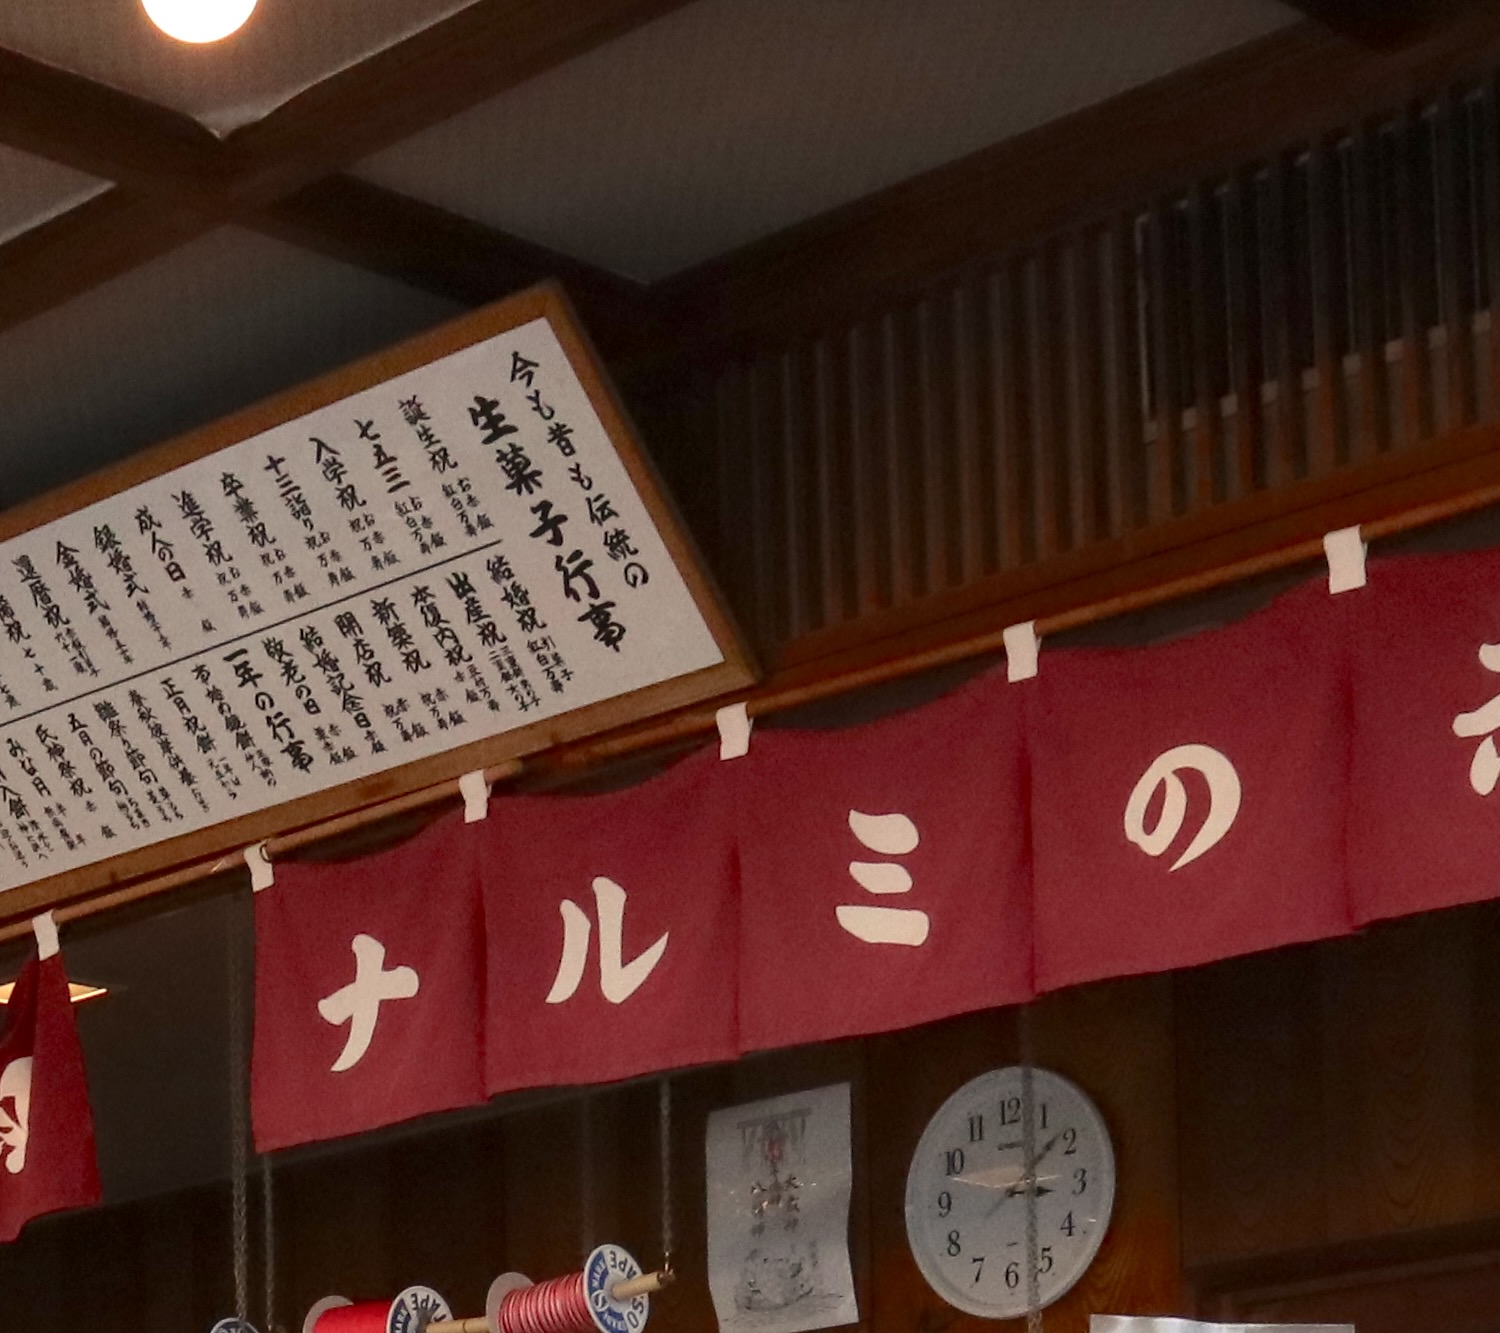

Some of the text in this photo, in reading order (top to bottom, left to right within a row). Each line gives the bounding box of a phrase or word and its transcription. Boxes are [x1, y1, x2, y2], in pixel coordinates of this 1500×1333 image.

[353, 419, 410, 494] 七五三
[398, 395, 458, 474] 誕生祝
[510, 351, 648, 592] 今も昔も伝統の
[221, 472, 276, 547] 卒業祝
[264, 455, 314, 532] 十三詣り
[309, 437, 367, 511] 入学祝
[94, 524, 149, 598] 銀婚式
[134, 505, 186, 582] 成人の日
[171, 490, 233, 566] 進学祝
[468, 395, 625, 652] 生菓子行事
[56, 541, 111, 615] 金婚式
[445, 571, 507, 647] 出産祝
[486, 554, 548, 634] 結婚祝
[333, 610, 393, 688] 開店祝
[370, 597, 431, 675] 新築祝
[410, 585, 473, 667] 本復内祝
[222, 648, 315, 774] 一年の行事
[261, 636, 322, 715] 敬老の日
[299, 625, 372, 730] 結婚記念日
[66, 712, 129, 796] 五月の節句
[967, 1114, 985, 1142] 11
[999, 1097, 1021, 1127] 12
[1040, 1104, 1049, 1129] 1
[1063, 1128, 1077, 1156] 2
[943, 1148, 965, 1177] 10
[1073, 1168, 1087, 1195] 3
[937, 1191, 953, 1218] 9
[1060, 1212, 1075, 1238] 4
[946, 1230, 962, 1258] 8
[971, 1257, 986, 1284] 7
[1004, 1262, 1019, 1289] 6
[1040, 1247, 1053, 1275] 5
